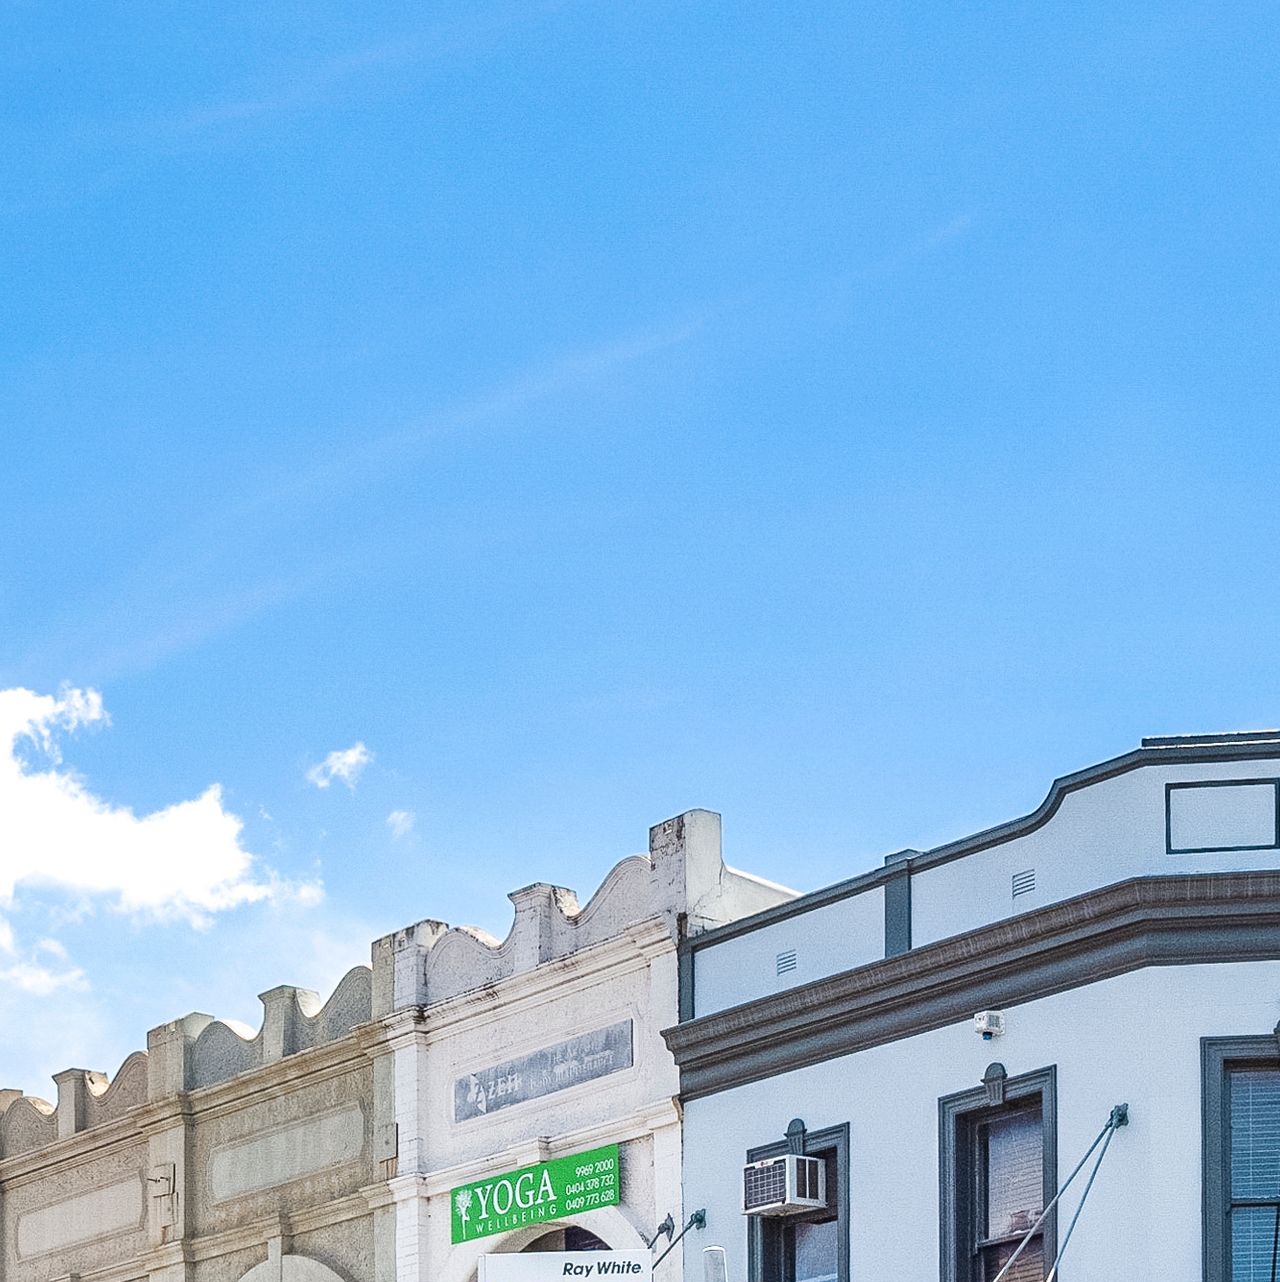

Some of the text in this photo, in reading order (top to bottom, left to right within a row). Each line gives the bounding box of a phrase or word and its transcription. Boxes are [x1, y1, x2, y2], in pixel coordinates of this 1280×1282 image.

[575, 1158, 614, 1177] 9969 2000
[474, 1169, 557, 1220] YOGA
[566, 1175, 615, 1196] 0404 378 732
[566, 1197, 585, 1211] 0409
[586, 1193, 600, 1207] 773
[476, 1206, 557, 1233] WELLBEING
[563, 1261, 642, 1278] Ray White
